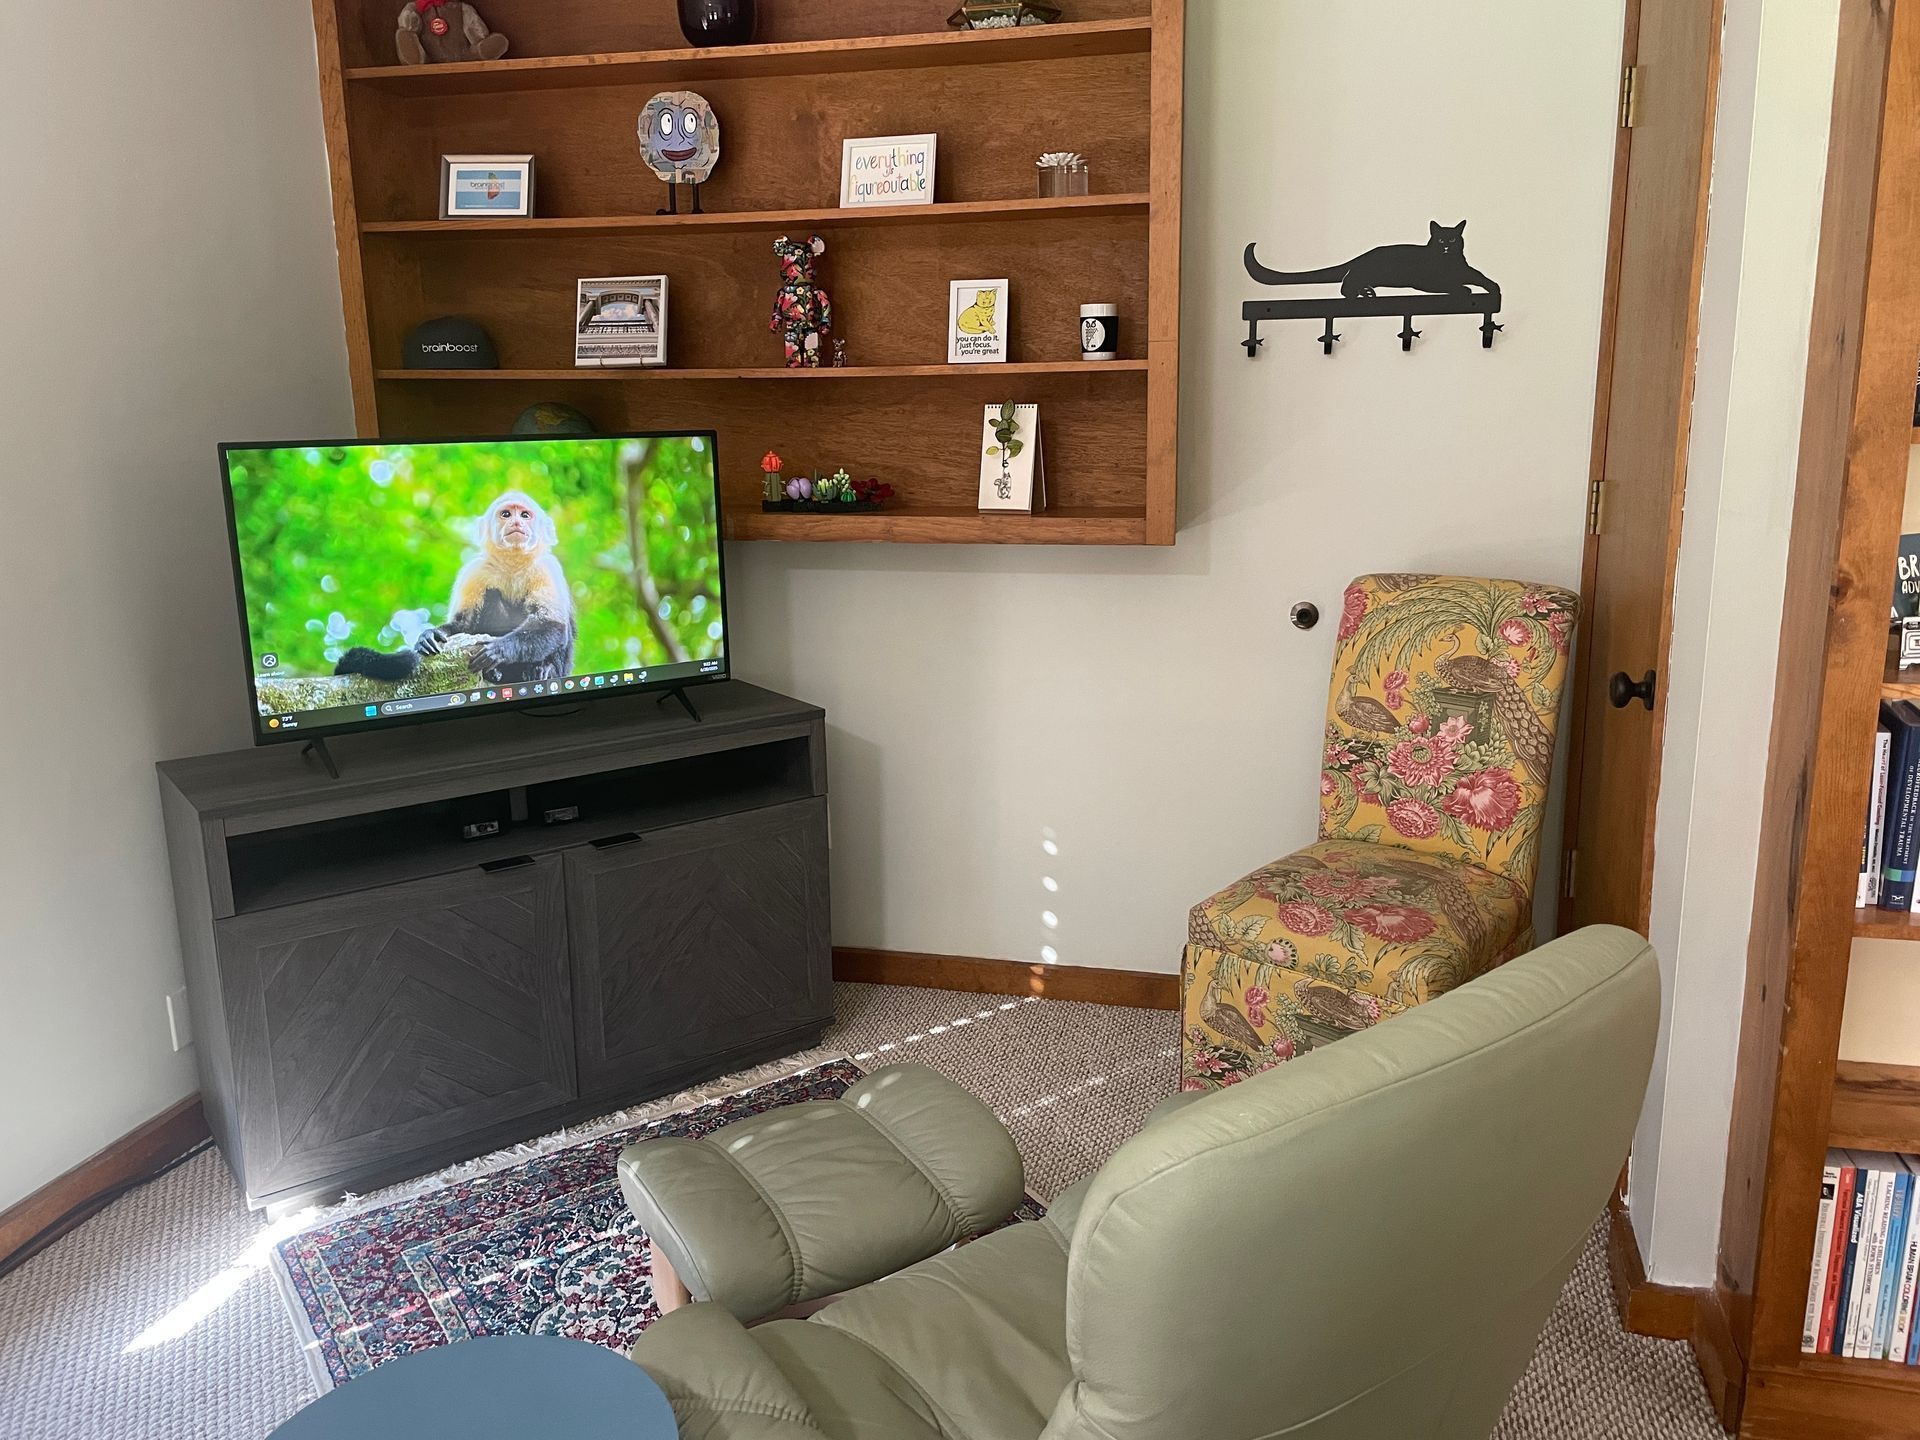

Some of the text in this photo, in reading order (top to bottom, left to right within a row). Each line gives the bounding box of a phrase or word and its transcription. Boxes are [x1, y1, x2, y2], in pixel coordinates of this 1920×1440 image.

[855, 147, 925, 176] everything
[849, 173, 926, 203] figureoutable
[421, 343, 478, 353] brainboost
[956, 336, 969, 344] you
[395, 703, 413, 711] Search
[1900, 774, 1914, 828] DEVELOPMENTAL
[1896, 830, 1906, 857] TRAUMA
[1903, 835, 1912, 865] TREATMENT
[1883, 1181, 1893, 1211] TEACHING
[1850, 1192, 1864, 1243] ABA Visualized
[1879, 1212, 1889, 1238] READING
[1868, 1244, 1878, 1263] DOWN
[1875, 1244, 1884, 1275] CHILDREN
[1907, 1241, 1918, 1265] HUMAN
[1865, 1264, 1874, 1295] SYNDROME
[1905, 1265, 1915, 1283] BRAIN
[1900, 1283, 1912, 1313] COLORING
[1897, 1314, 1908, 1333] BOOK
